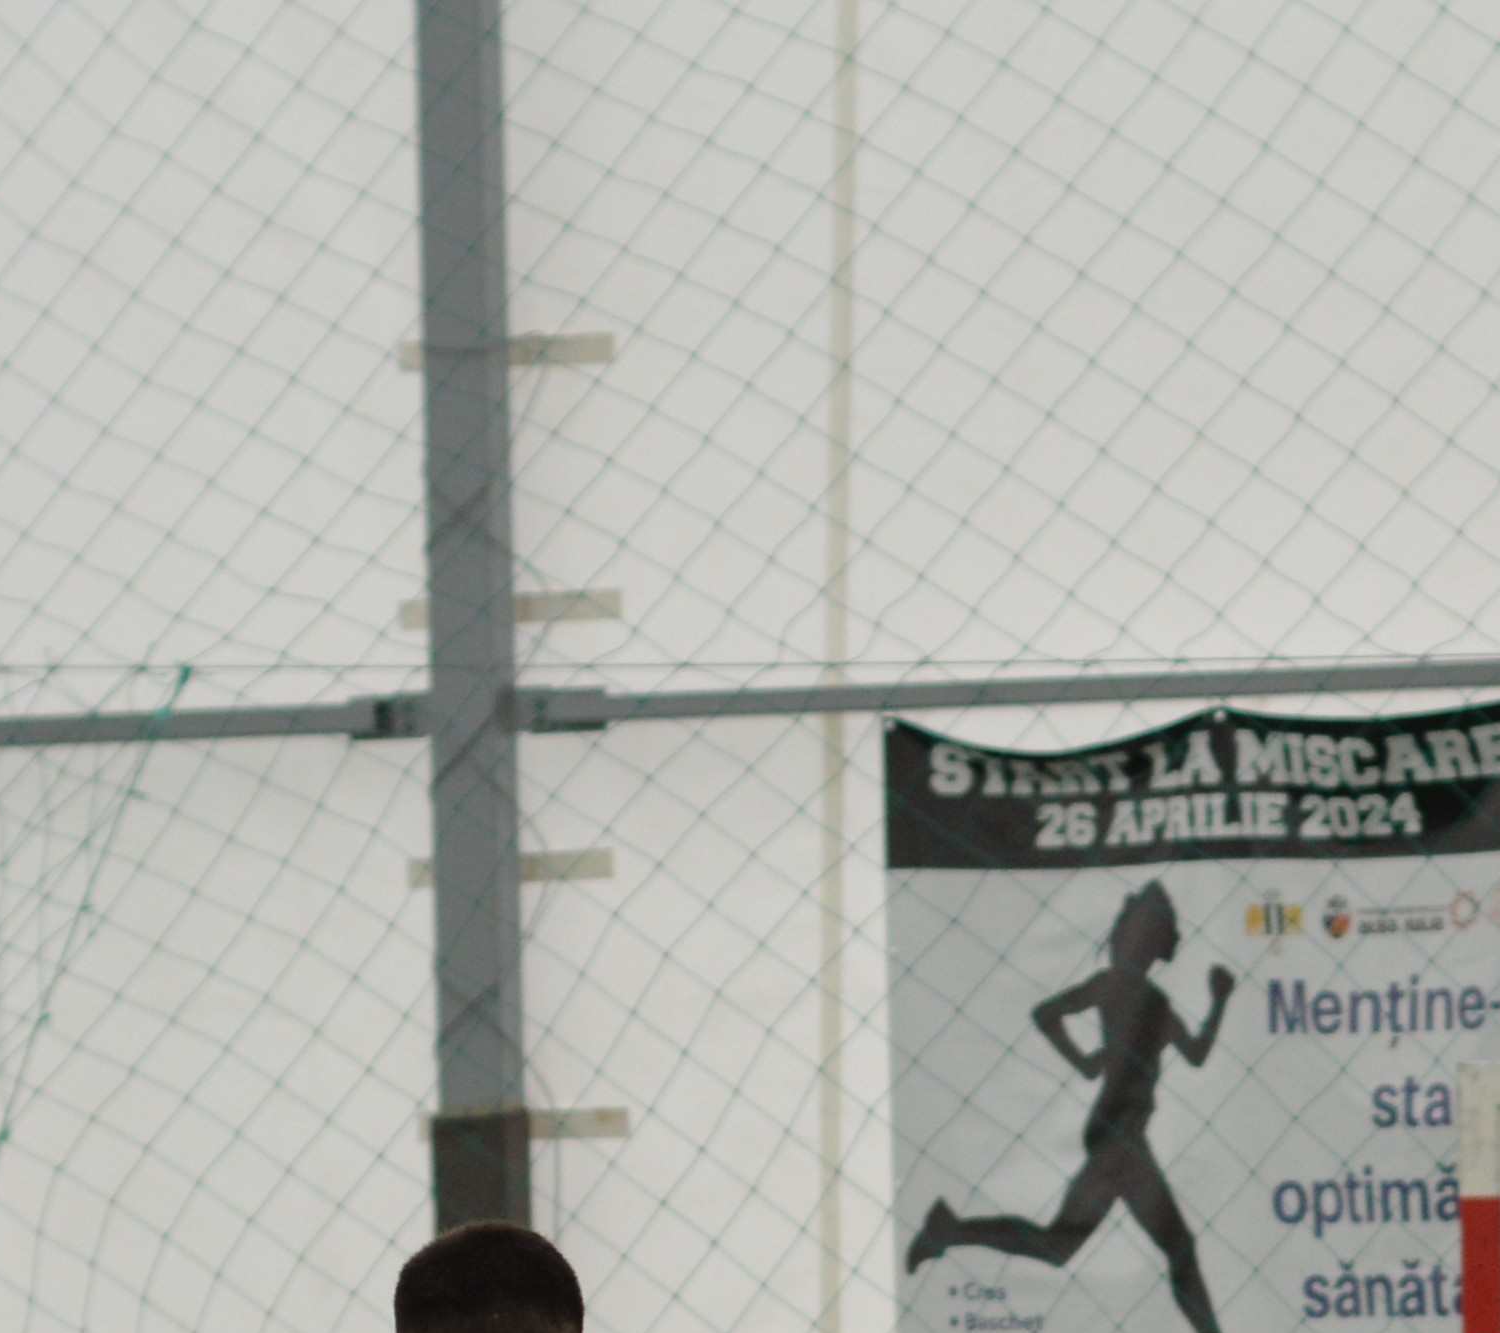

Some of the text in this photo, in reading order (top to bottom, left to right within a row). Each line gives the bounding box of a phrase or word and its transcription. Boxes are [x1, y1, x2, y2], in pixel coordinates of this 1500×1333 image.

[928, 741, 1131, 796] START
[1145, 730, 1224, 791] LA
[1034, 791, 1423, 850] 26 APRILIE 2024
